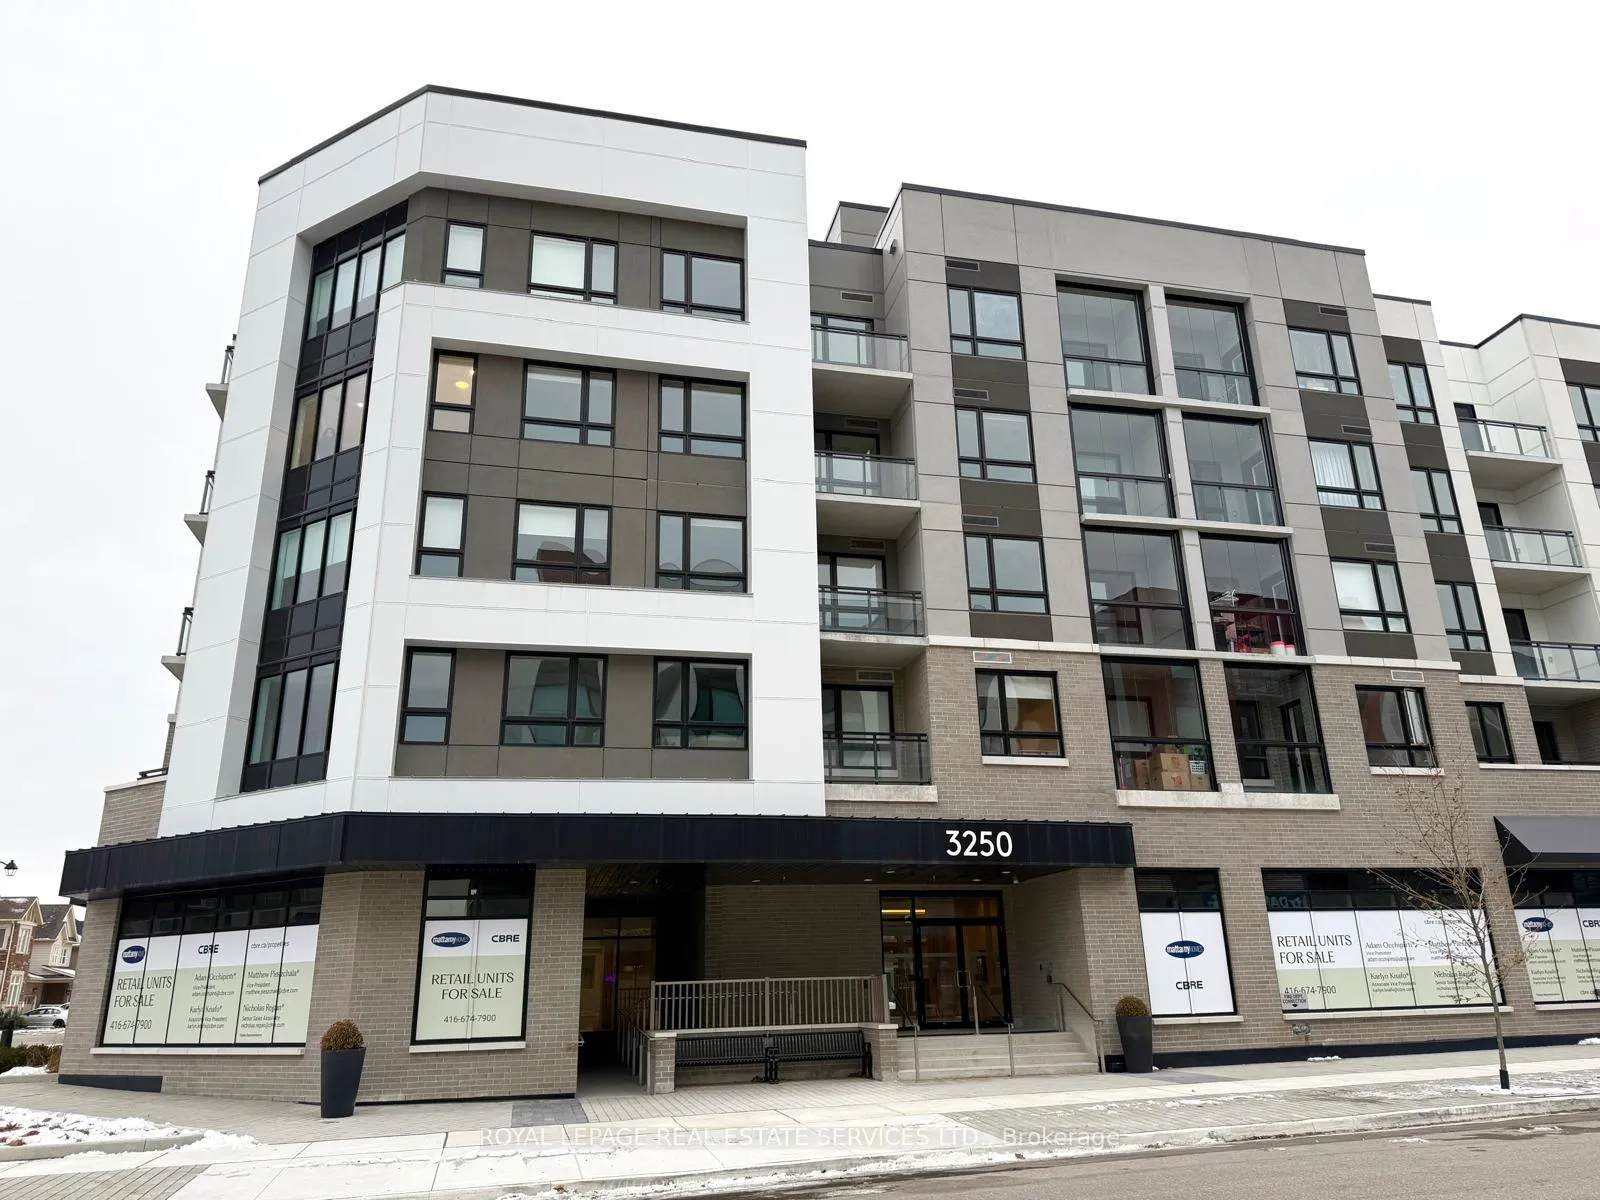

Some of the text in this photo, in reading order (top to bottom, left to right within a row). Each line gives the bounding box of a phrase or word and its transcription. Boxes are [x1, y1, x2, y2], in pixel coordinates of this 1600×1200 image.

[946, 830, 1013, 858] 3250
[1582, 920, 1600, 928] CBR
[492, 934, 520, 942] CBRE
[1277, 934, 1352, 948] RETAIL UNITS
[198, 944, 220, 954] CBRE
[1280, 950, 1336, 964] FOR SALE
[117, 976, 172, 990] RETAIL UNITS
[432, 972, 514, 985] RETAIL UNITS
[1176, 980, 1204, 990] CBRE
[1284, 986, 1336, 994] 416-674-7900
[442, 988, 502, 1000] FOR SALE
[114, 994, 155, 1008] FOR SALE
[444, 1014, 496, 1023] 416-674-7900
